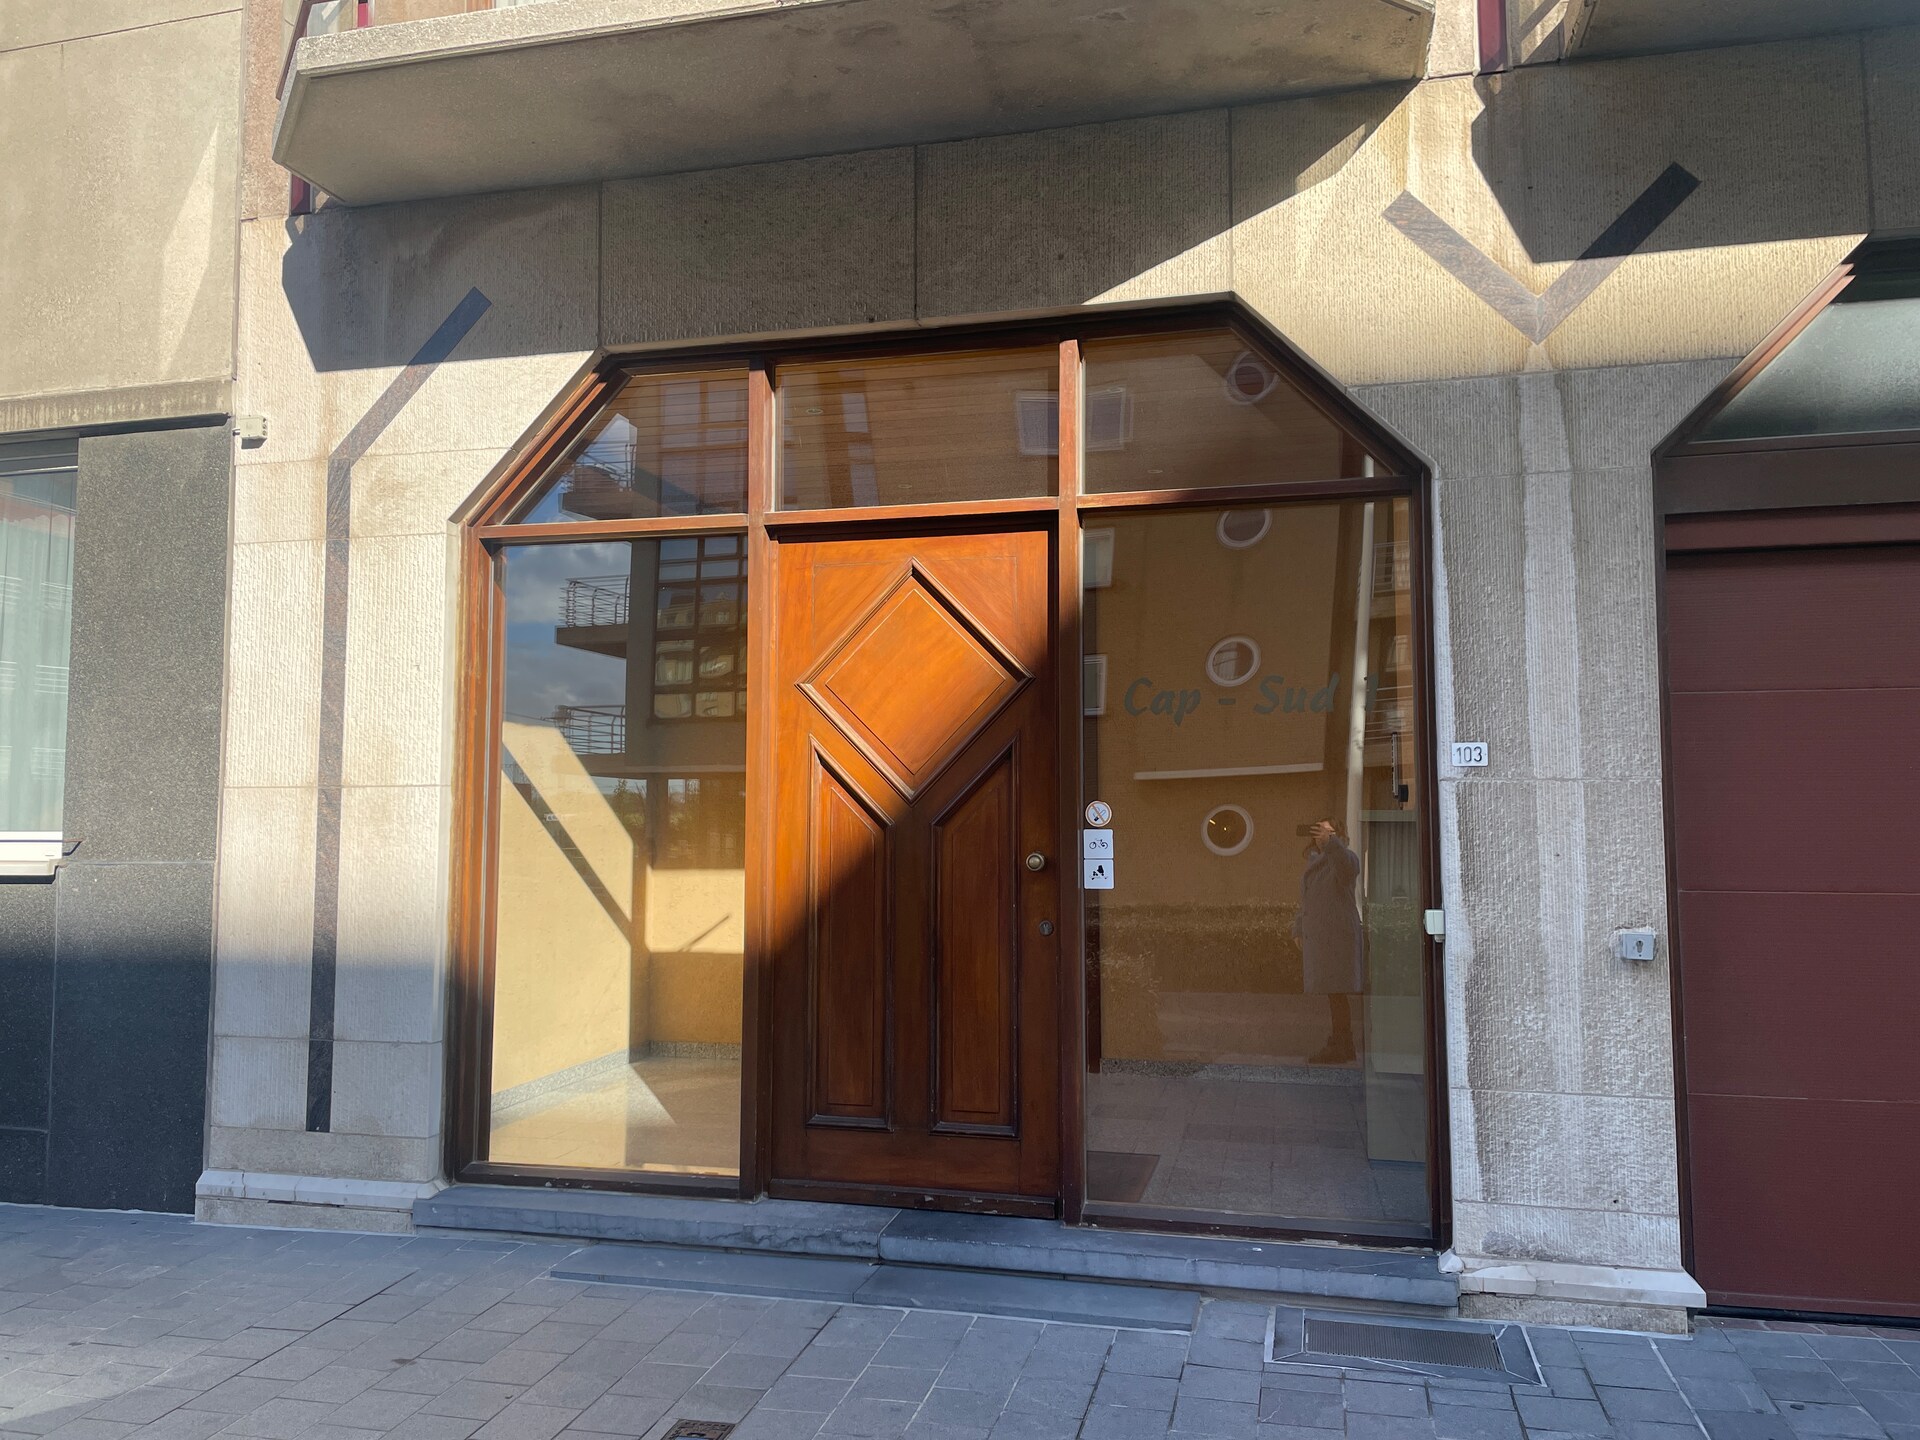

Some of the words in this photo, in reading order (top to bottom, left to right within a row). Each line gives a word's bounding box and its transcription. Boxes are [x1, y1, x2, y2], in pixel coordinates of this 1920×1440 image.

[1123, 676, 1200, 727] Cap
[1253, 672, 1340, 714] Sud
[1456, 746, 1482, 764] 103
